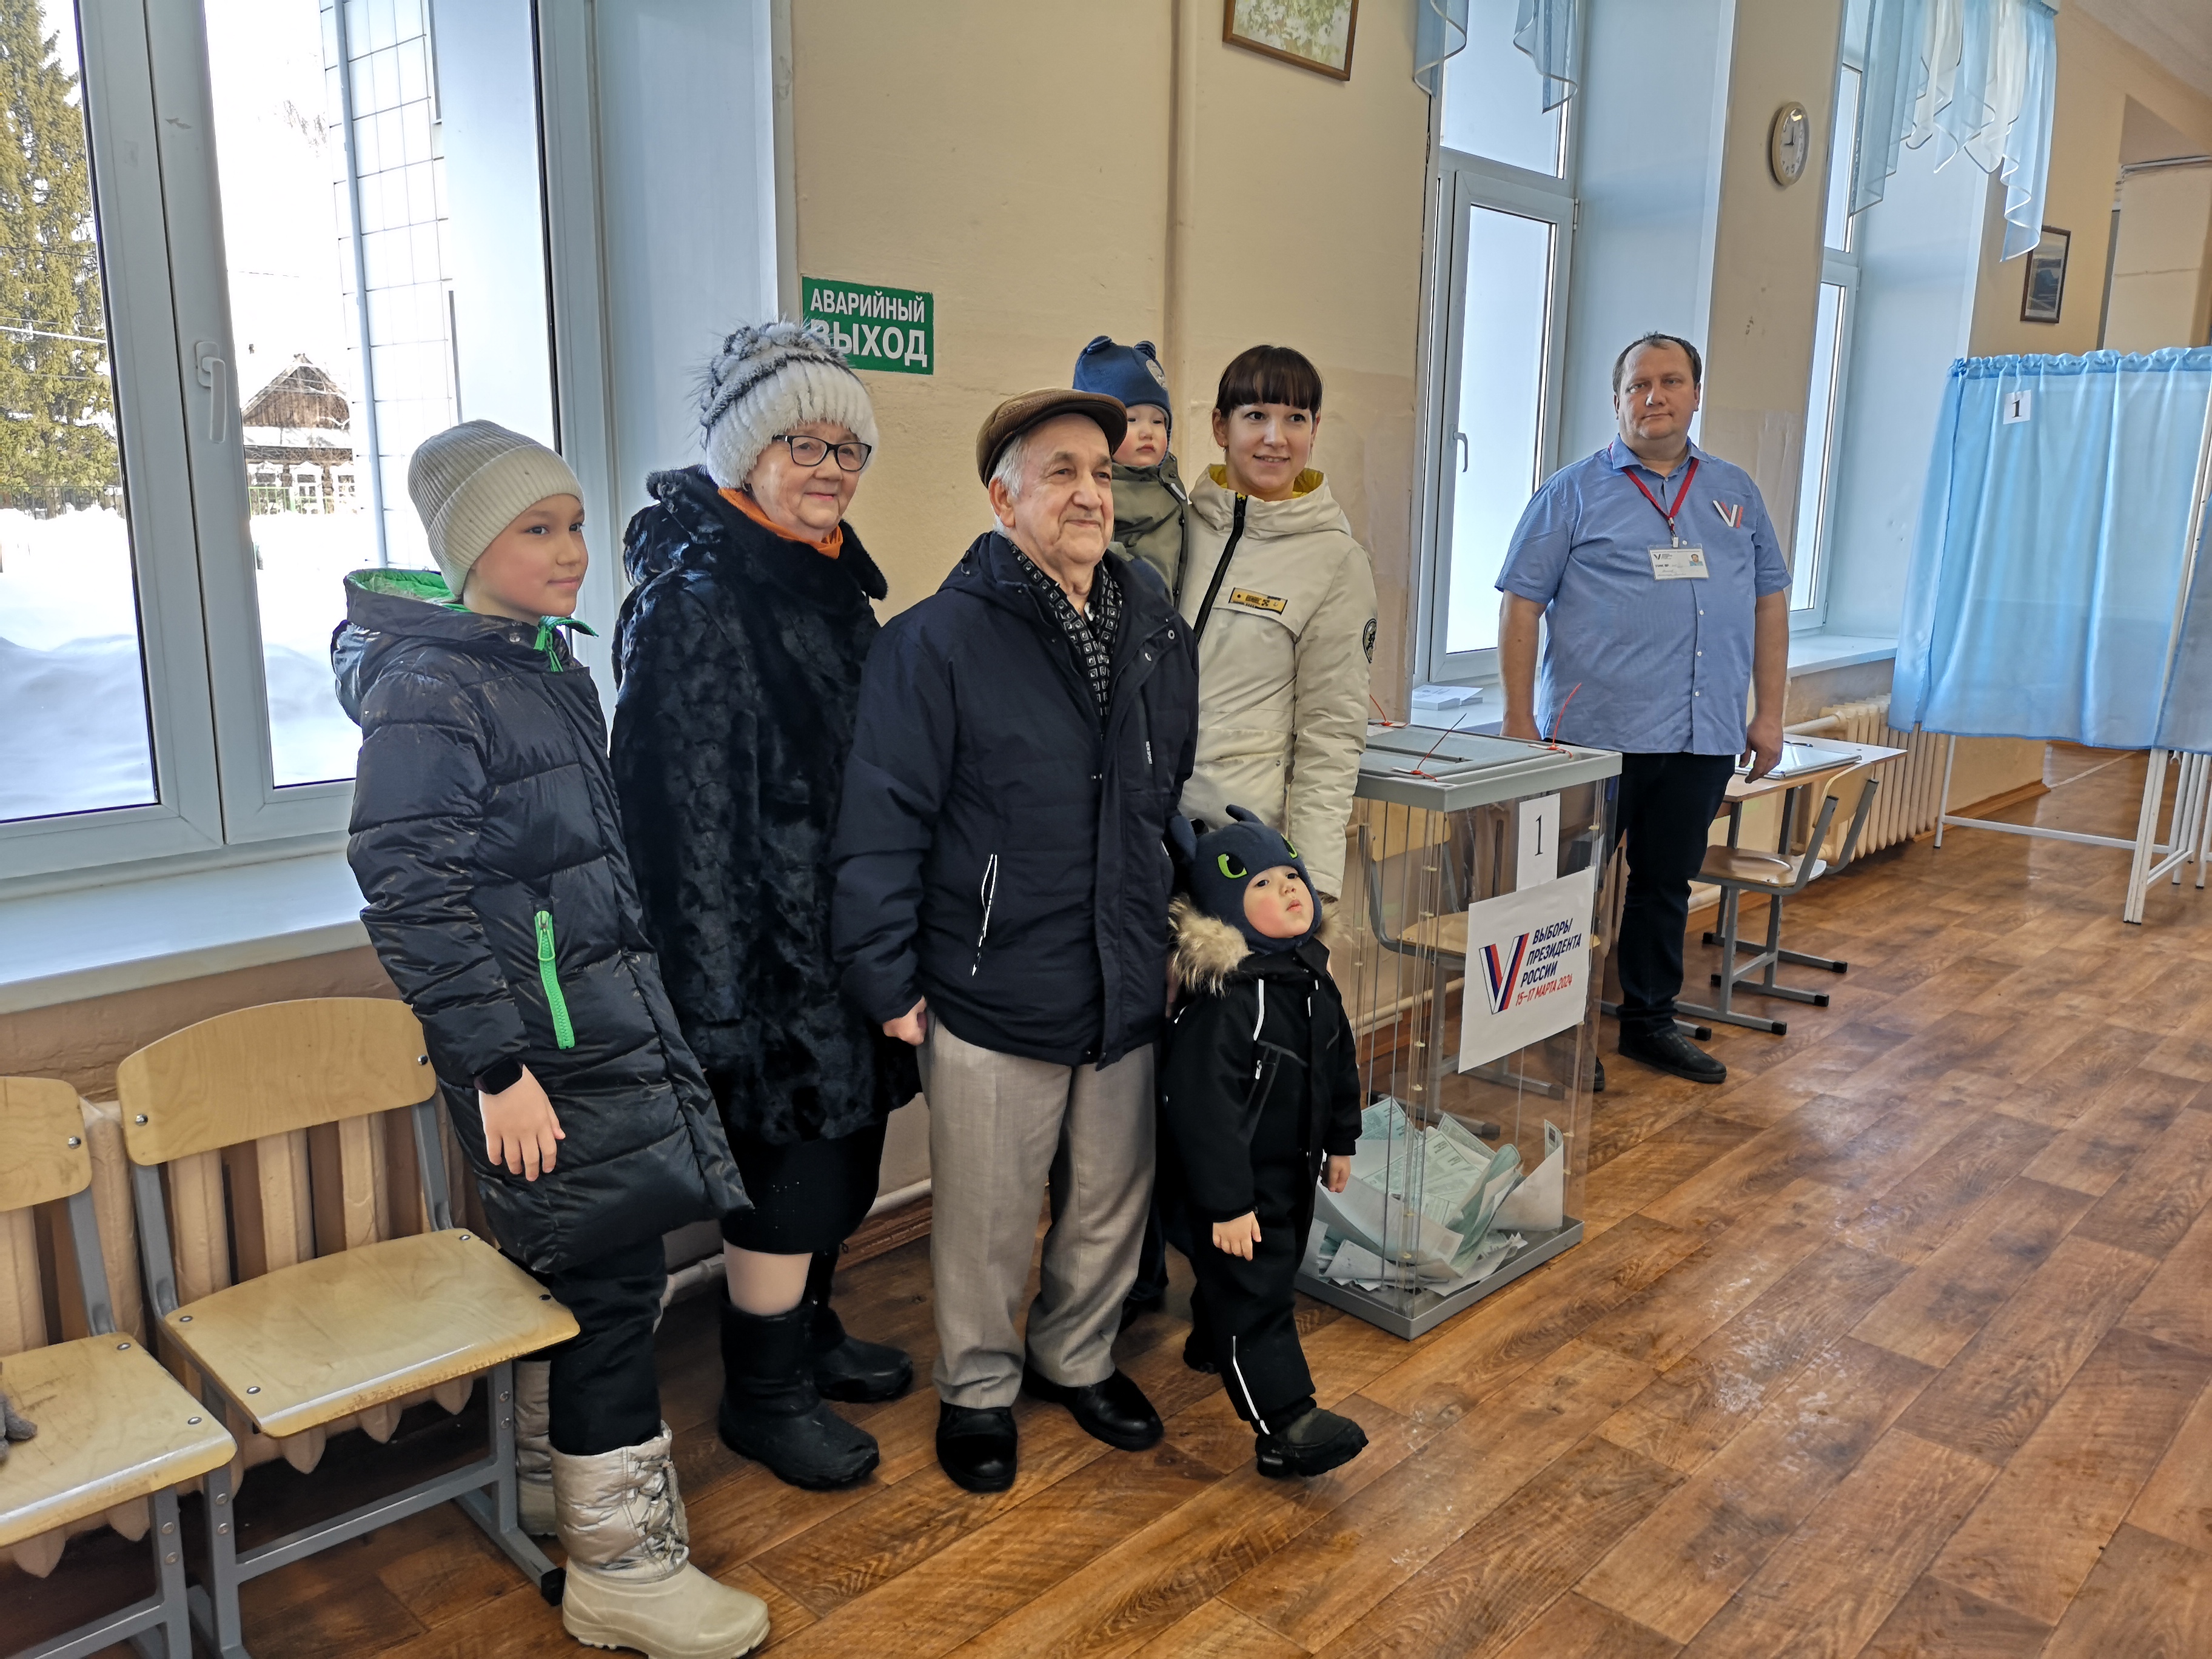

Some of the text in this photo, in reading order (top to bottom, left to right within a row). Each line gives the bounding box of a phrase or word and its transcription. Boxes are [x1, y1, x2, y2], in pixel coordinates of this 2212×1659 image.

[810, 288, 925, 323] АВАРИЙНЫЙ
[811, 318, 928, 367] ВЫХОД
[2011, 399, 2022, 418] 1
[1534, 814, 1543, 856] 1
[1532, 917, 1574, 945] ВЫБОРЫ
[1526, 933, 1582, 967] ПРЕЗИДЕНТА
[1515, 973, 1573, 1007] 15-17 МАРТА 2024
[1520, 960, 1558, 988] РОССИИ
